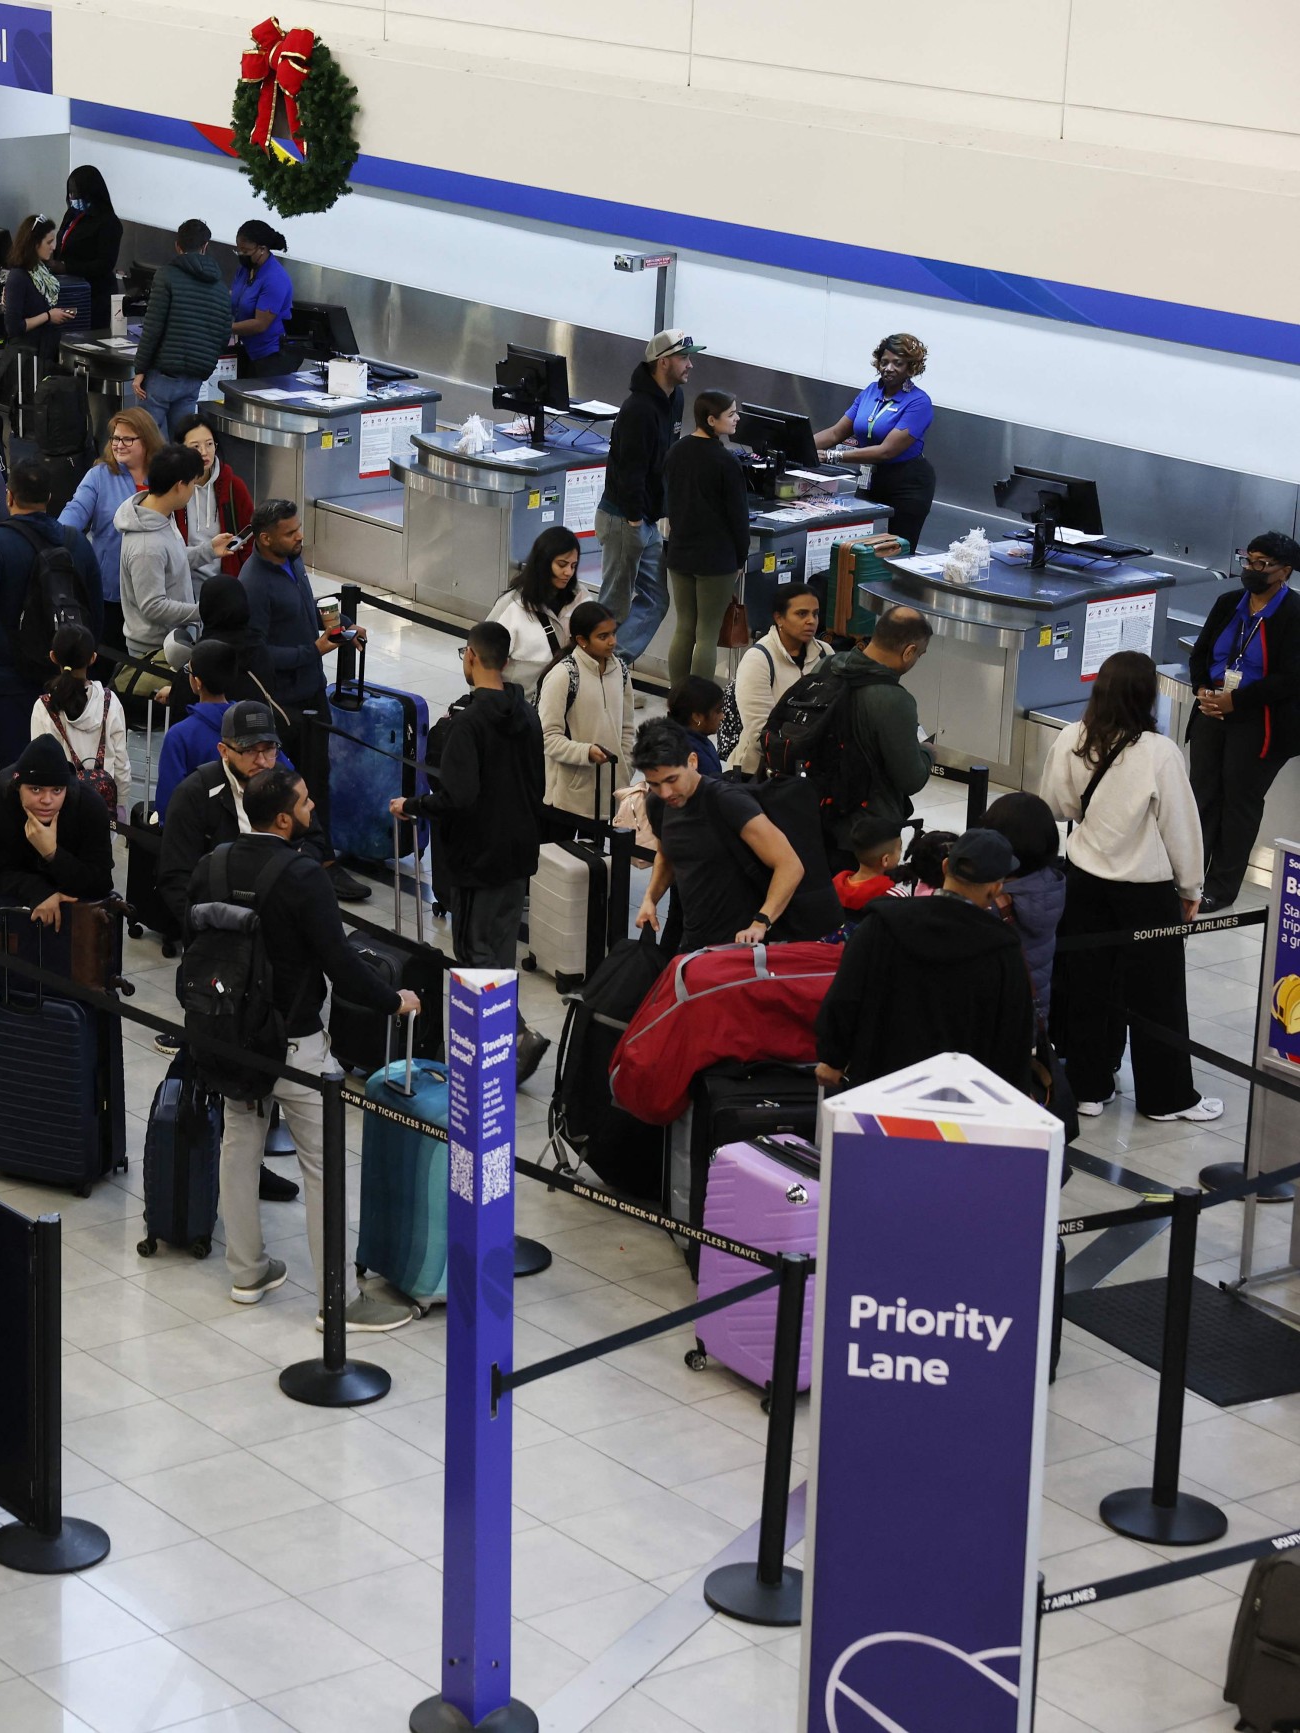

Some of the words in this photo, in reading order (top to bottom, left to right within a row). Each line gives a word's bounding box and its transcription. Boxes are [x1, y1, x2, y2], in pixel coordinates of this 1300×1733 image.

[1133, 923, 1193, 941] SOUTHWEST
[1195, 916, 1239, 932] AIRLINES
[1281, 933, 1288, 943] a
[483, 999, 512, 1018] Southwest
[451, 1028, 476, 1056] Traveling
[482, 1033, 513, 1054] Traveling
[451, 1045, 473, 1066] abroad?
[482, 1047, 510, 1070] abroad?
[362, 1099, 377, 1112] FOR
[378, 1105, 420, 1129] TICKETLESS
[421, 1123, 448, 1140] TRAVEL
[573, 1184, 591, 1198] SWA
[592, 1191, 617, 1208] RAPID
[619, 1201, 658, 1223] CHECK-IN
[660, 1217, 677, 1231] FOR
[678, 1224, 728, 1249] TICKETLESS
[729, 1243, 762, 1262] TRAVEL
[850, 1294, 1013, 1352] Priority
[847, 1342, 950, 1386] Lane
[1051, 1587, 1097, 1610] AIRLINES
